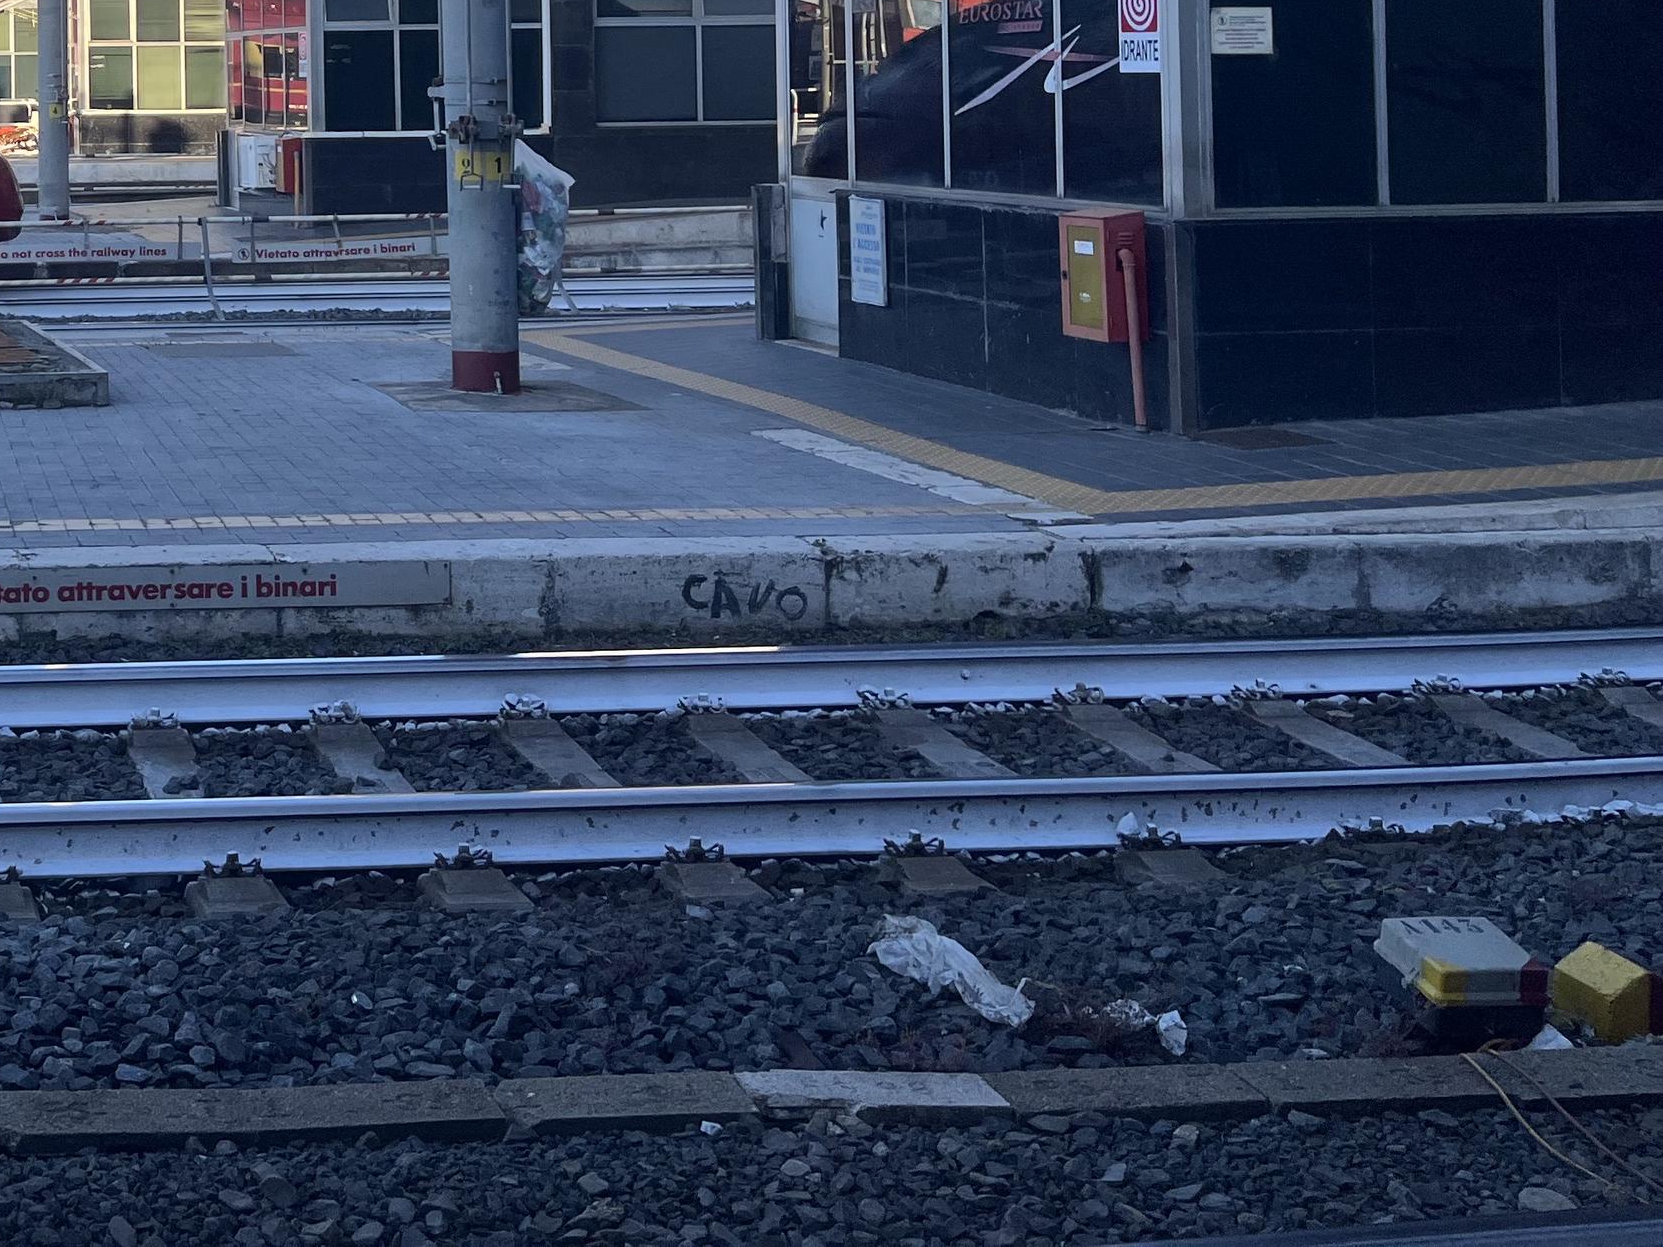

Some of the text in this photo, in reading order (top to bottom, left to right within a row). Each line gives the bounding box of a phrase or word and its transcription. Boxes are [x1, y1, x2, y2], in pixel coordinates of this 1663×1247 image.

[958, 0, 1043, 24] EUROSTAR
[1121, 39, 1159, 62] IDRANTE
[494, 156, 502, 174] 1
[11, 249, 32, 259] not
[35, 249, 65, 258] cross
[68, 246, 88, 258] the
[90, 246, 136, 259] railway
[139, 245, 167, 257] lines
[255, 247, 300, 260] Vietato
[380, 242, 416, 254] binari
[57, 581, 235, 603] attraversare
[240, 575, 248, 599] i
[255, 573, 338, 598] binari
[681, 573, 808, 622] CAVO
